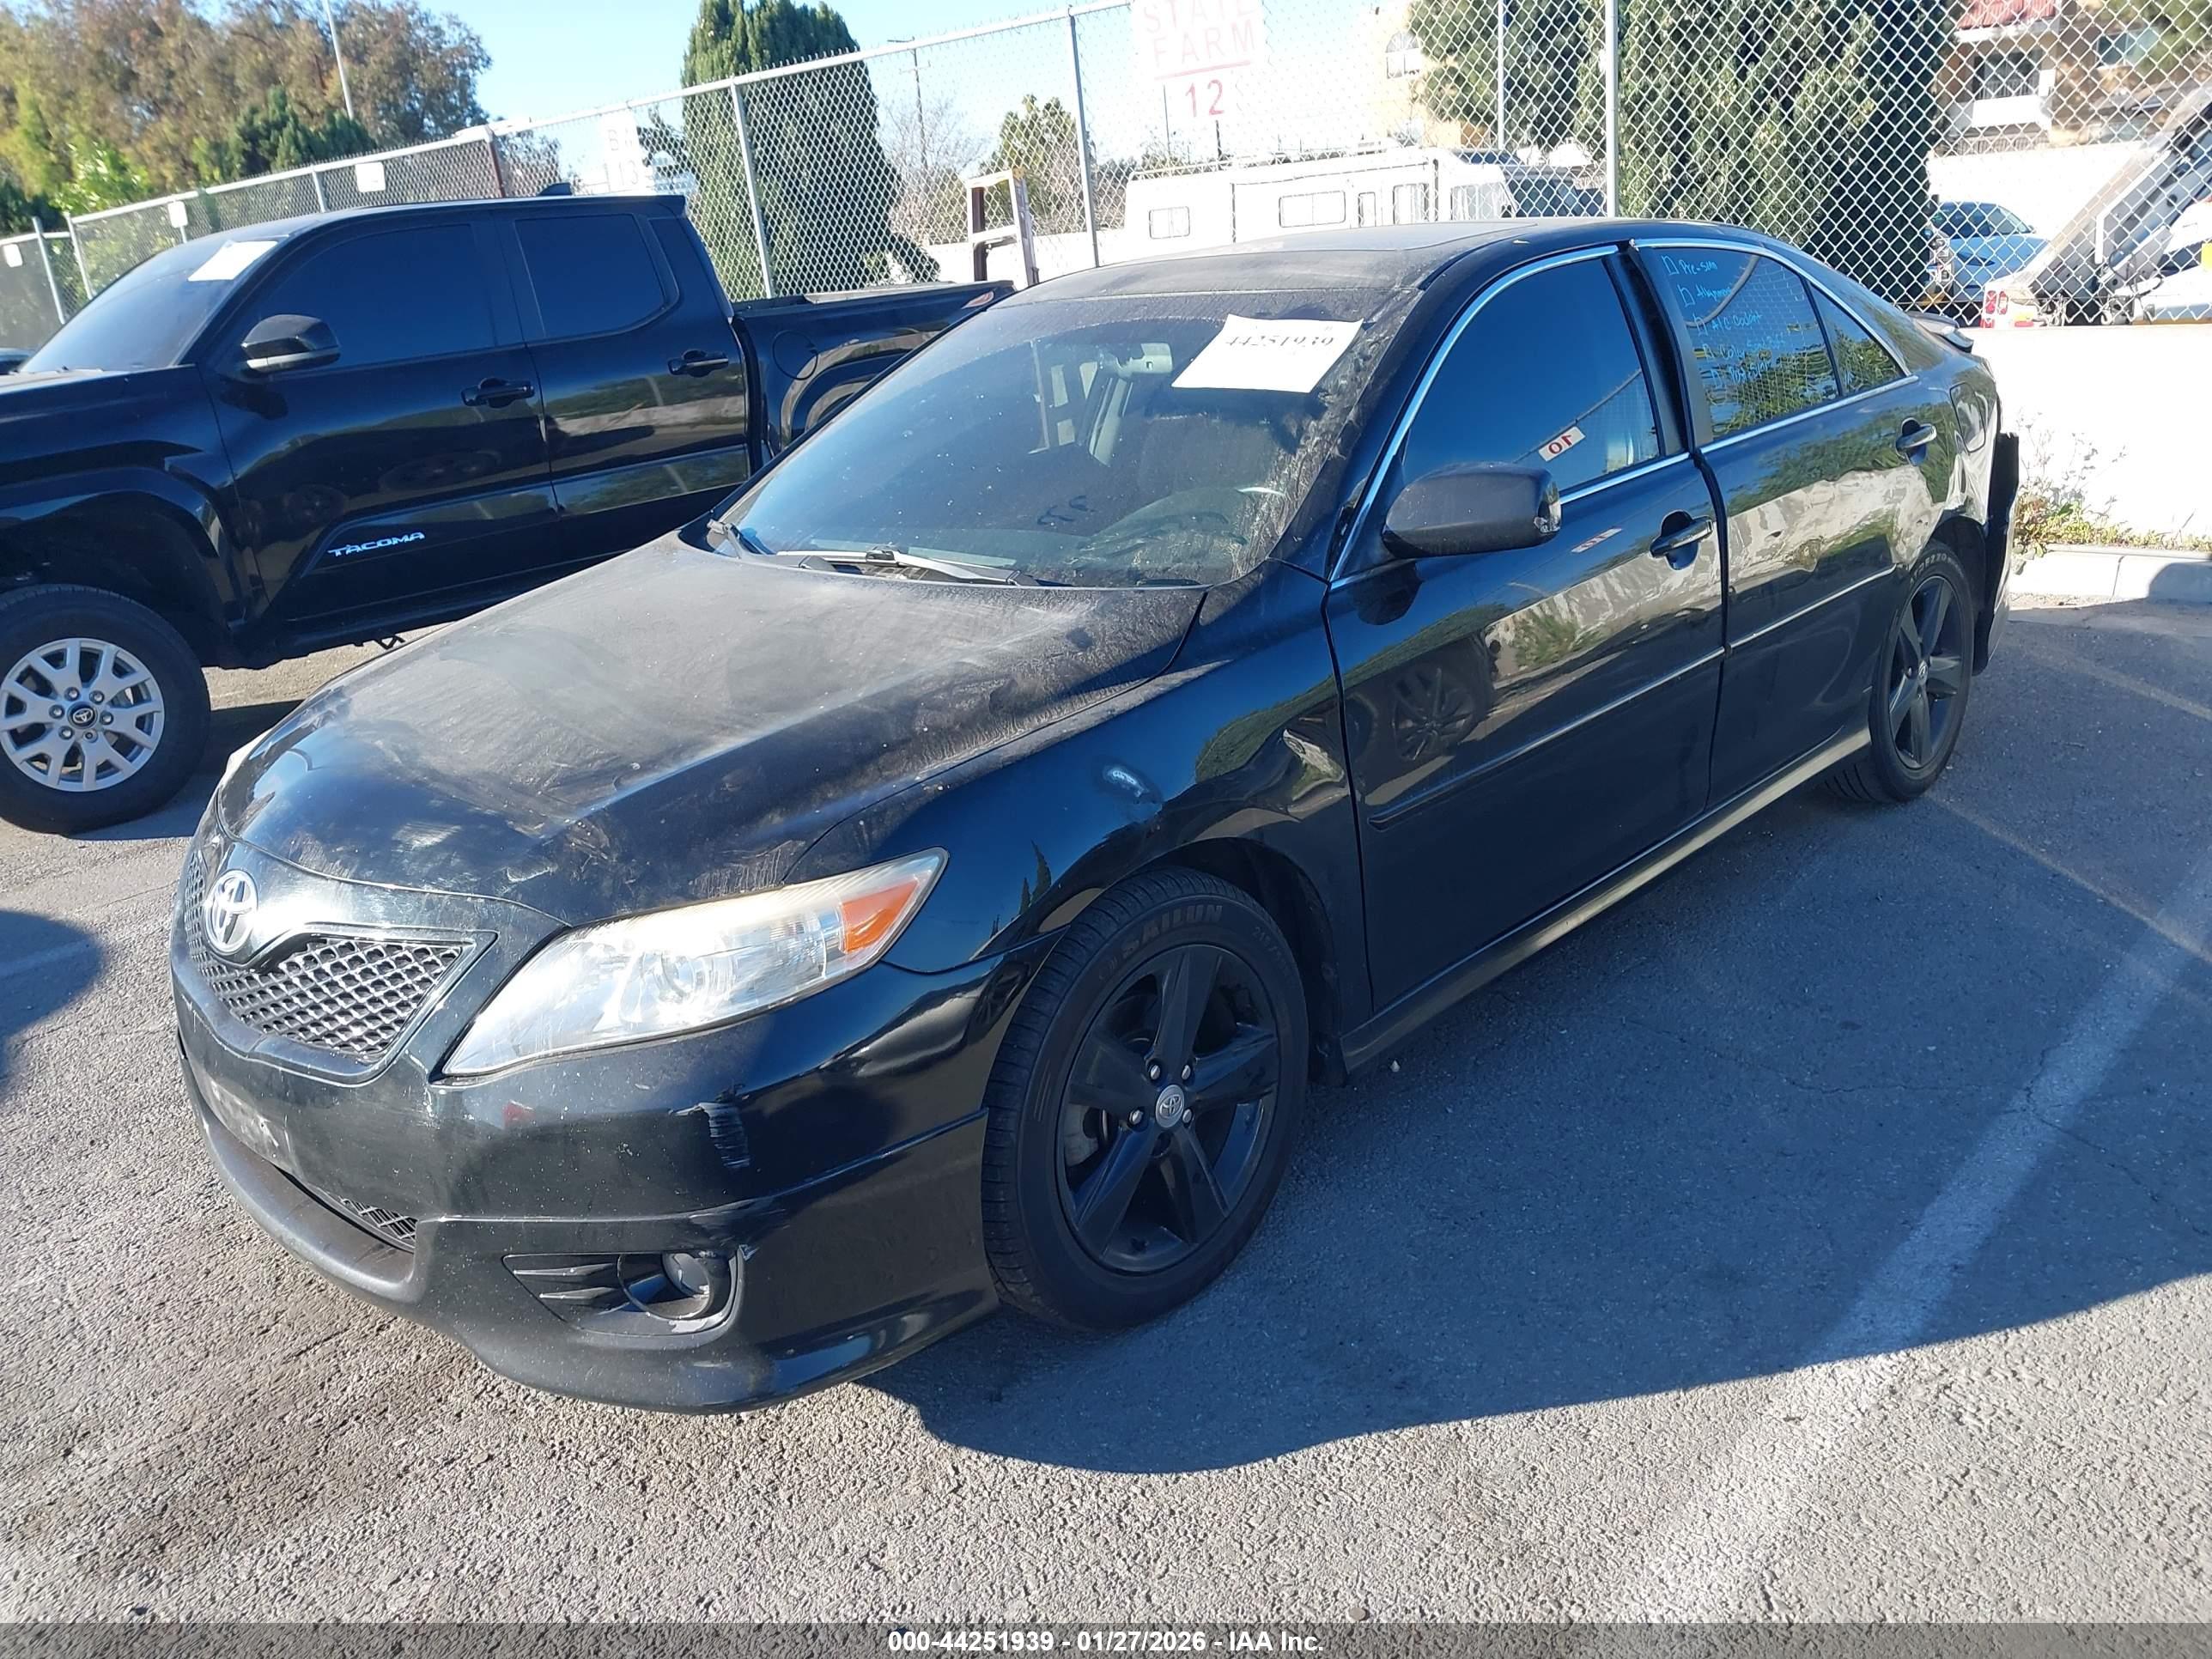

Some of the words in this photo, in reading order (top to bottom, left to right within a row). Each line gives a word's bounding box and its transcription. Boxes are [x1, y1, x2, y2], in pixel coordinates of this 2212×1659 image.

[1152, 20, 1255, 67] FARM
[1185, 79, 1224, 118] 12
[327, 532, 425, 556] TACOMA
